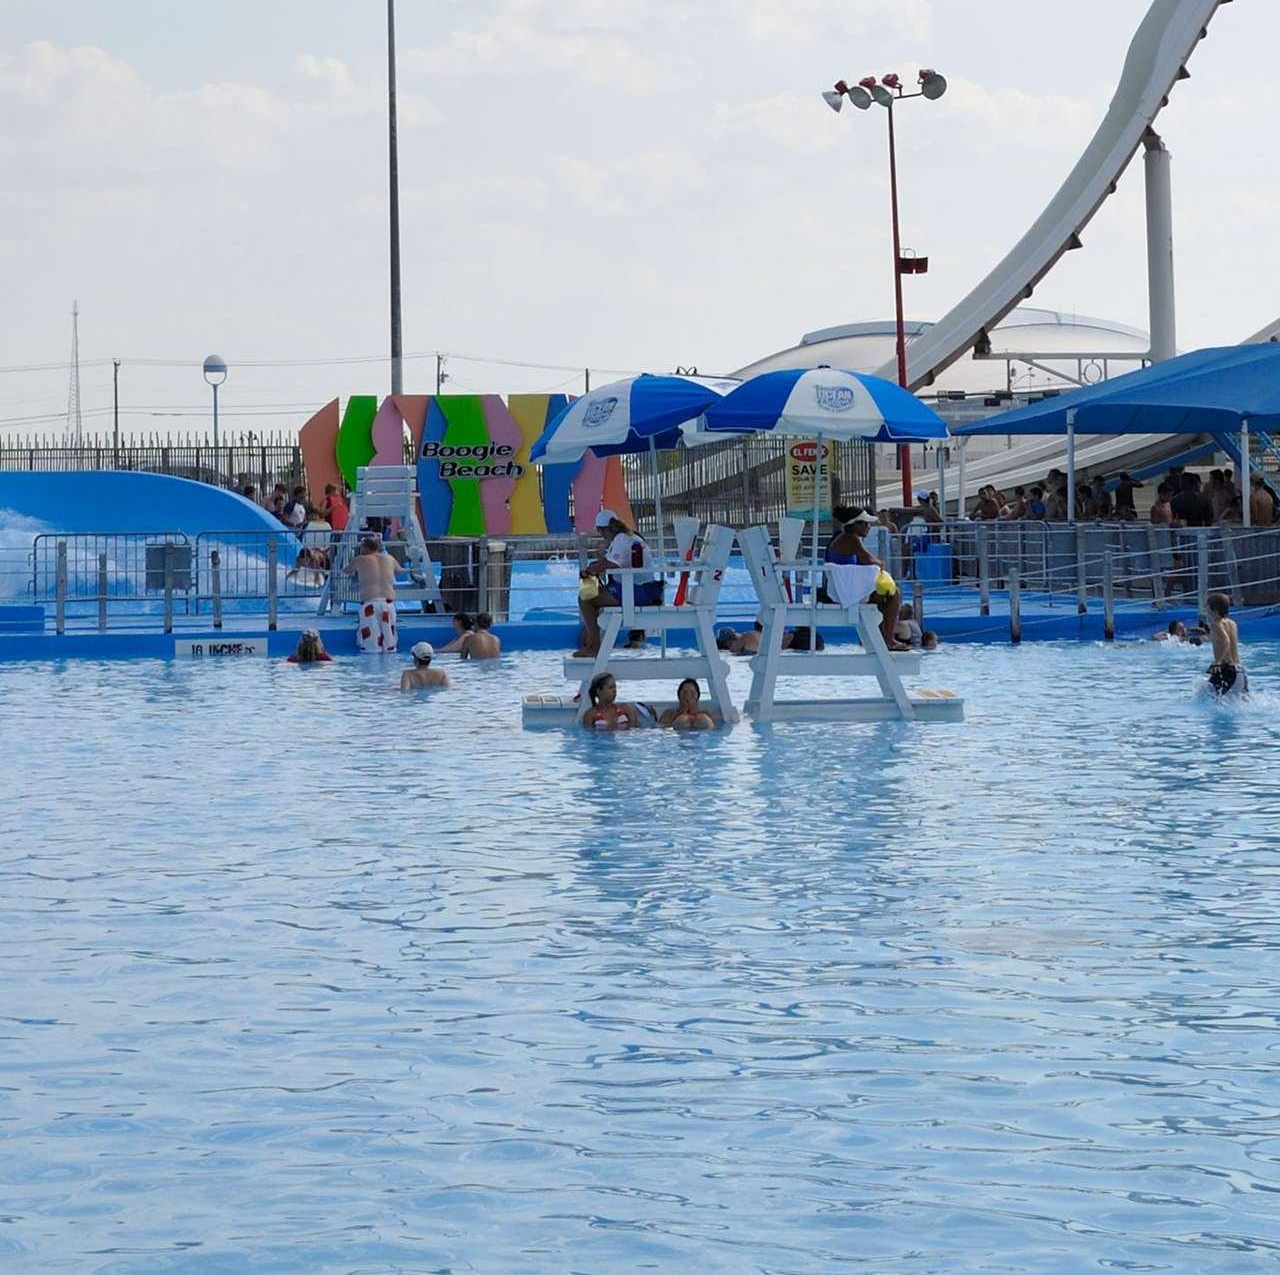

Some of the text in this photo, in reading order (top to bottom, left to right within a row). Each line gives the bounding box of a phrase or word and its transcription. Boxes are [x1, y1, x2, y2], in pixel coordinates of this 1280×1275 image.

[421, 441, 513, 460] Boogie
[440, 461, 523, 477] Beach
[792, 465, 827, 475] SAVE
[713, 569, 722, 581] 2
